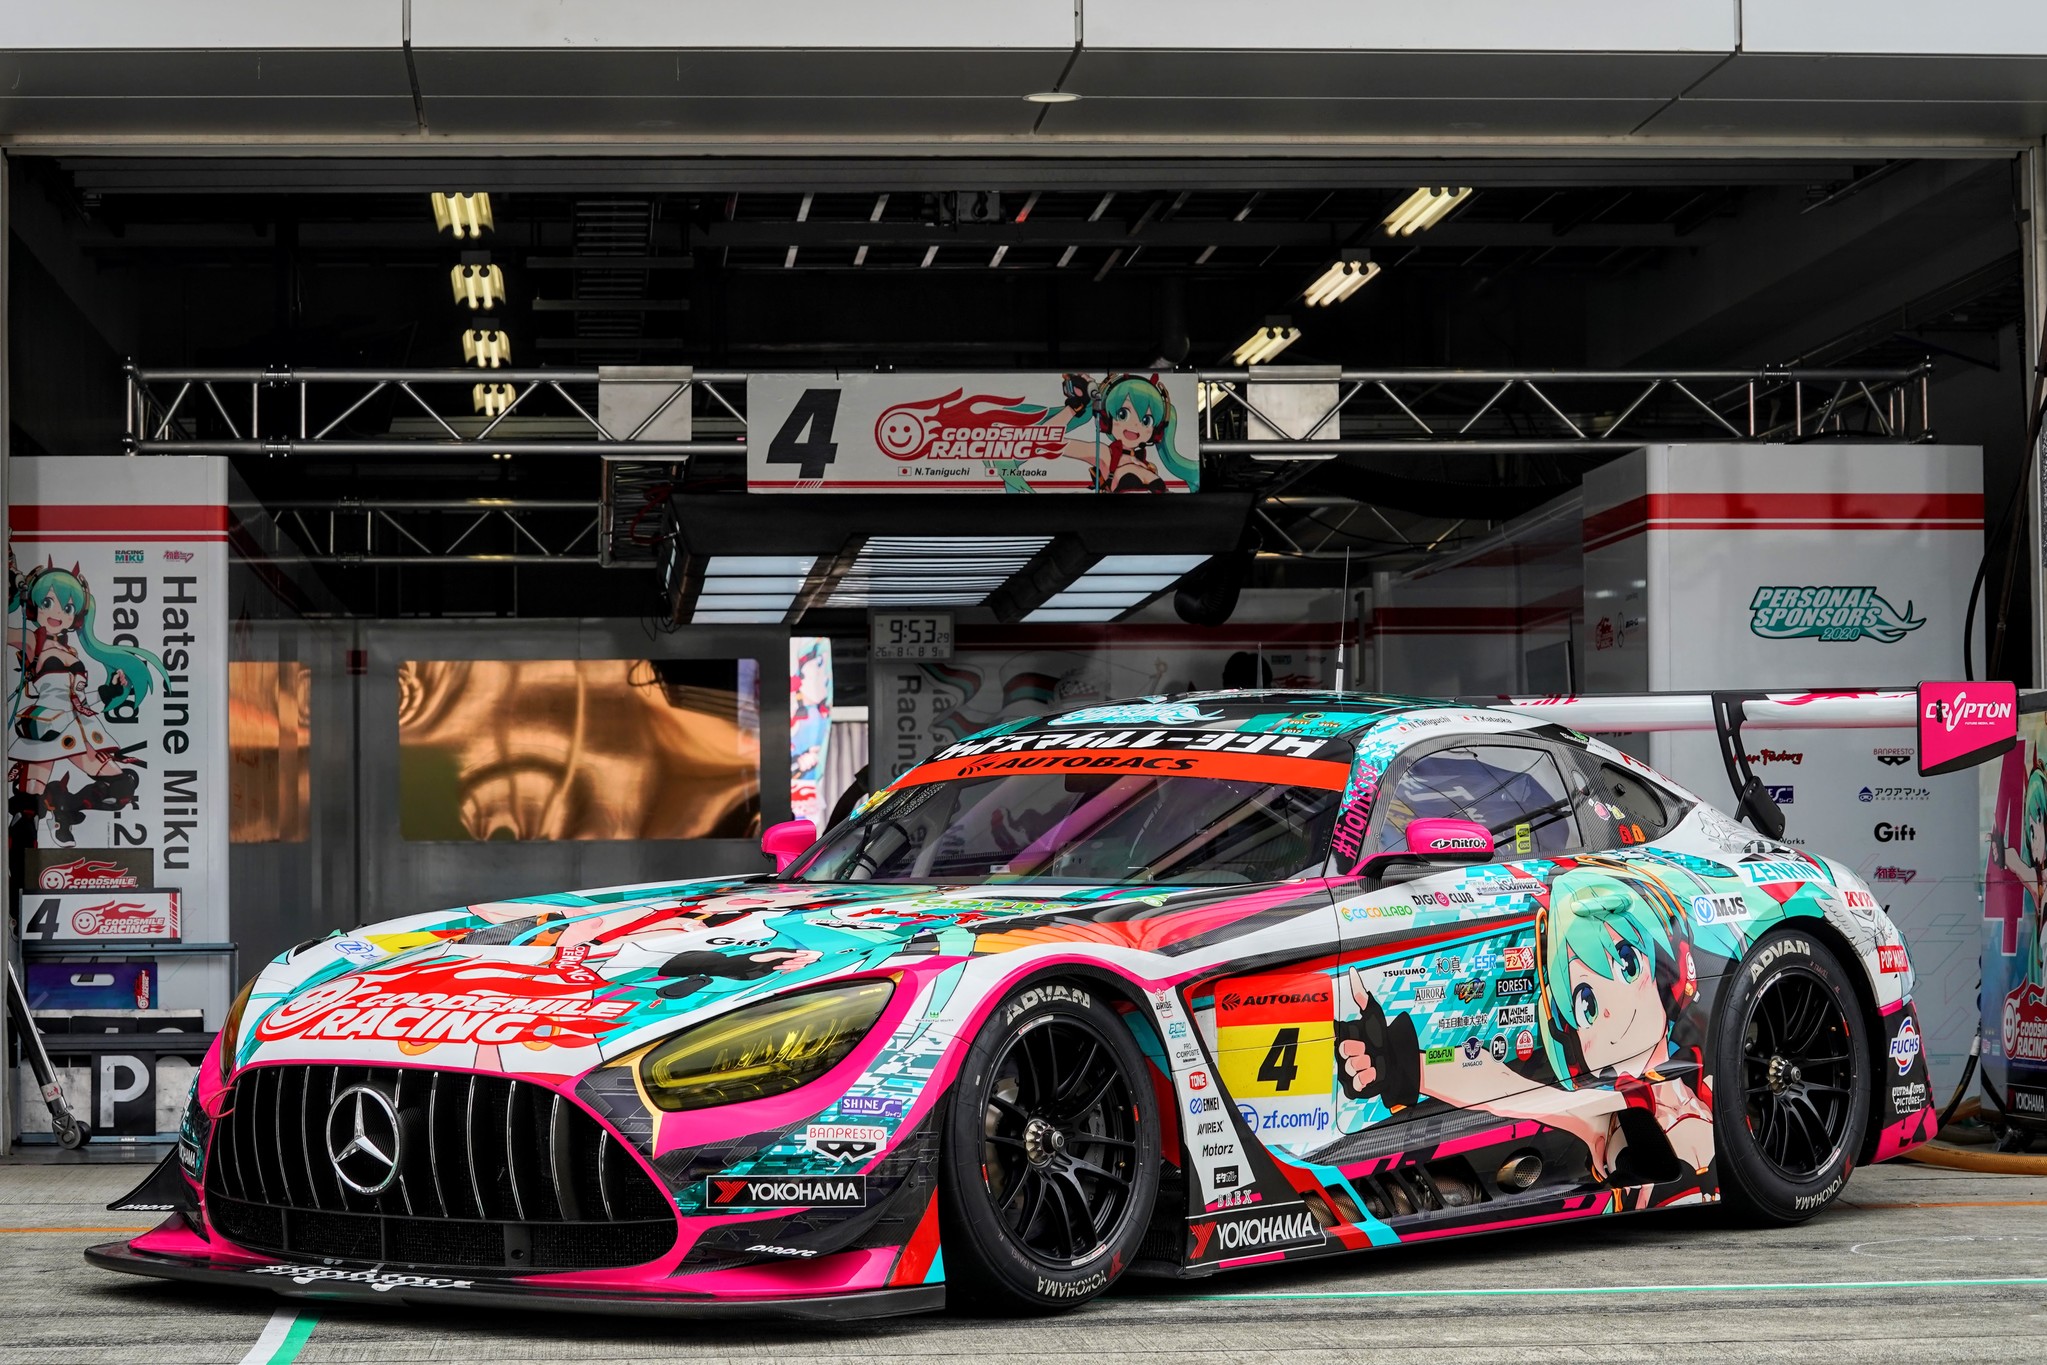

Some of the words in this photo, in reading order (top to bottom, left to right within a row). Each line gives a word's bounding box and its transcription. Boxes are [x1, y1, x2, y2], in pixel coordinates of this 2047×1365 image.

[766, 388, 842, 479] 4
[942, 427, 1065, 442] GOODSMILE
[928, 441, 1033, 459] RACING
[914, 467, 970, 477] N.Taniguchi
[1001, 468, 1047, 477] T.Kataoka
[1754, 588, 1874, 608] PERSONAL
[1754, 607, 1881, 627] SPONSORS
[890, 620, 936, 643] 9:53
[1823, 628, 1860, 640] 2020
[162, 576, 197, 755] Hatsune
[996, 756, 1200, 771] AUTOBACS
[1875, 788, 1930, 796] アクアマリン
[1332, 759, 1379, 860] #fightgsr
[163, 770, 197, 870] Miku
[1874, 822, 1916, 843] Gift
[1450, 838, 1487, 849] nitro+
[1741, 861, 1824, 883] ZENRIN
[1873, 865, 1917, 884] 初音ミク
[74, 878, 135, 886] GOODSMILE
[1412, 893, 1436, 907] DIGI
[1449, 891, 1475, 903] CLUB
[1714, 896, 1748, 917] MJS
[26, 898, 62, 940] 4
[105, 917, 165, 926] GOODSMILE
[1352, 905, 1413, 919] COCOLLABO
[99, 924, 149, 935] RACING
[705, 936, 771, 948] Gift
[1475, 954, 1497, 970] ESR
[1751, 940, 1811, 985] ADVAN
[1881, 950, 1893, 969] POP
[1383, 967, 1426, 978] TSUKUMO
[1415, 986, 1446, 1001] AURORA
[1497, 978, 1528, 993] FOREST
[364, 991, 633, 1019] GOODSMILE
[1006, 985, 1092, 1026] ADVAN
[1242, 992, 1329, 1006] AUTOBACS
[308, 1009, 536, 1042] RACING
[1428, 1048, 1453, 1060] GO&FUN
[1890, 1037, 1920, 1055] FUCHS
[1257, 1027, 1300, 1092] 4
[1190, 1074, 1206, 1088] TONE
[100, 1055, 150, 1128] P
[843, 1098, 879, 1110] SHINE
[2015, 1092, 2045, 1113] YOKOHAMA
[1262, 1107, 1329, 1131] zf.com/jp
[809, 1127, 885, 1140] BANPRESTO
[1202, 1144, 1234, 1158] Motorz
[748, 1182, 860, 1201] YOKOHAMA
[1217, 1189, 1253, 1208] BREX
[1795, 1174, 1843, 1210] YOKOHAMA
[1216, 1211, 1317, 1250] YOKOHAMA
[1036, 1268, 1107, 1299] YOKOHAMA
